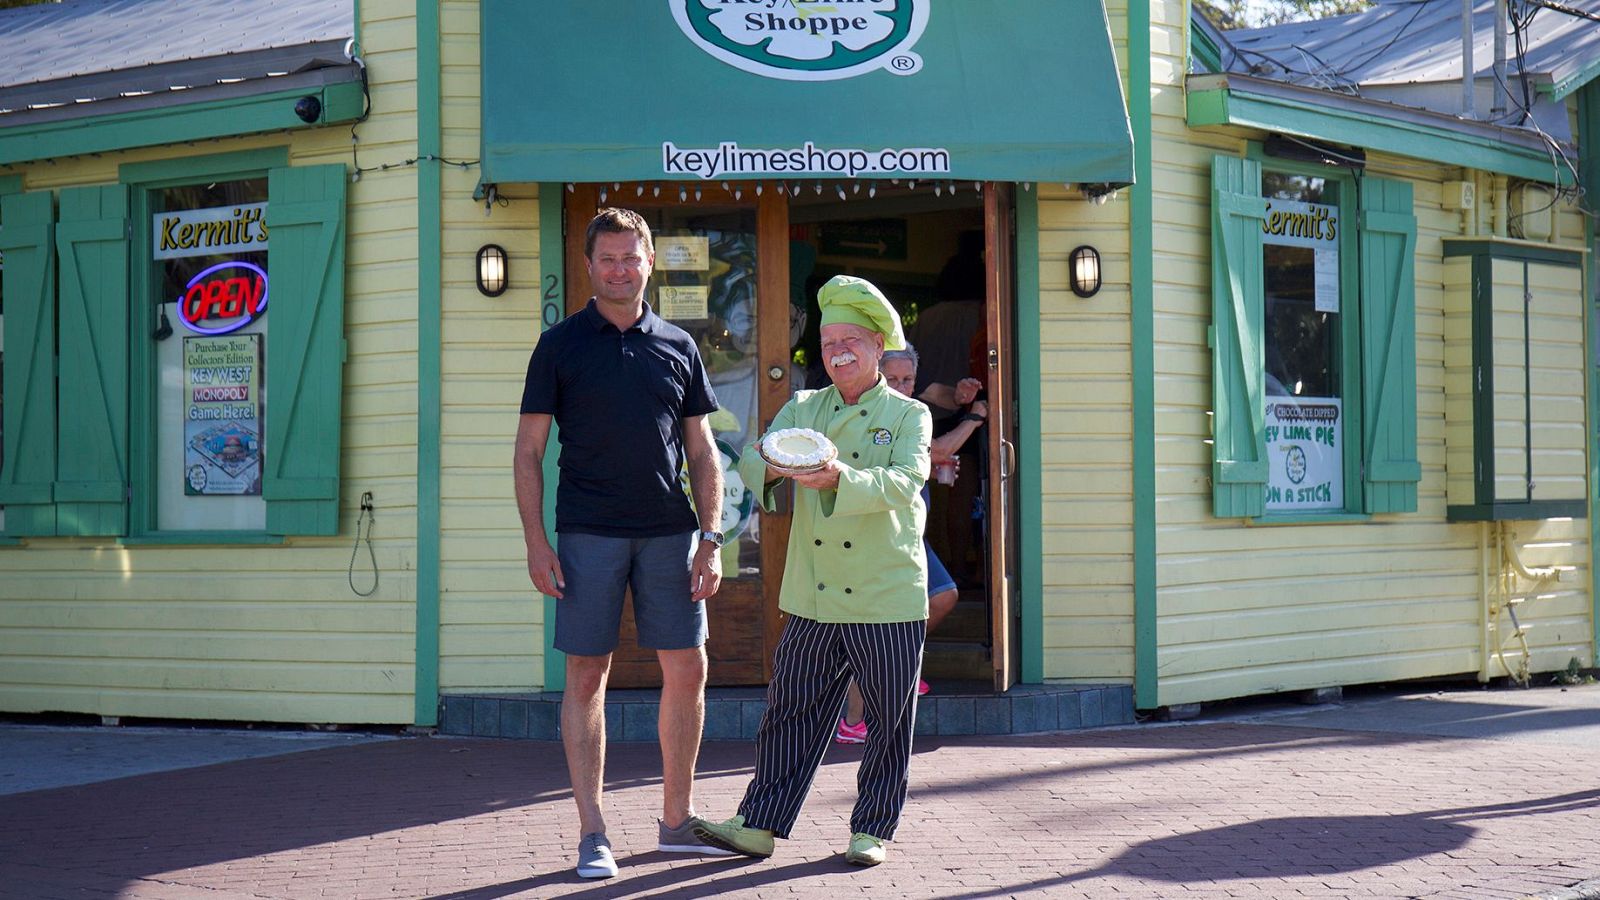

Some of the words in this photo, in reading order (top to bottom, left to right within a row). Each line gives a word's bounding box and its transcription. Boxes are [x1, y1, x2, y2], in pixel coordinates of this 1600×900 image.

[744, 12, 869, 36] Shoppe
[665, 144, 949, 178] keylimeshop.com
[160, 207, 269, 251] Kermit's
[183, 275, 263, 323] OPEN
[195, 341, 228, 353] Purchase
[229, 341, 247, 352] Your
[226, 353, 254, 364] Edition
[191, 367, 215, 384] KEY
[216, 366, 253, 383] WEST
[194, 387, 248, 401] MONOPOLY
[189, 404, 220, 420] Game
[222, 403, 255, 420] Here!
[1277, 407, 1313, 417] CHOCOLATE
[1314, 407, 1336, 417] DIPPED
[1283, 425, 1312, 441] LIME
[1315, 426, 1335, 448] PIE
[1285, 488, 1294, 503] A
[1297, 481, 1331, 502] STICK
